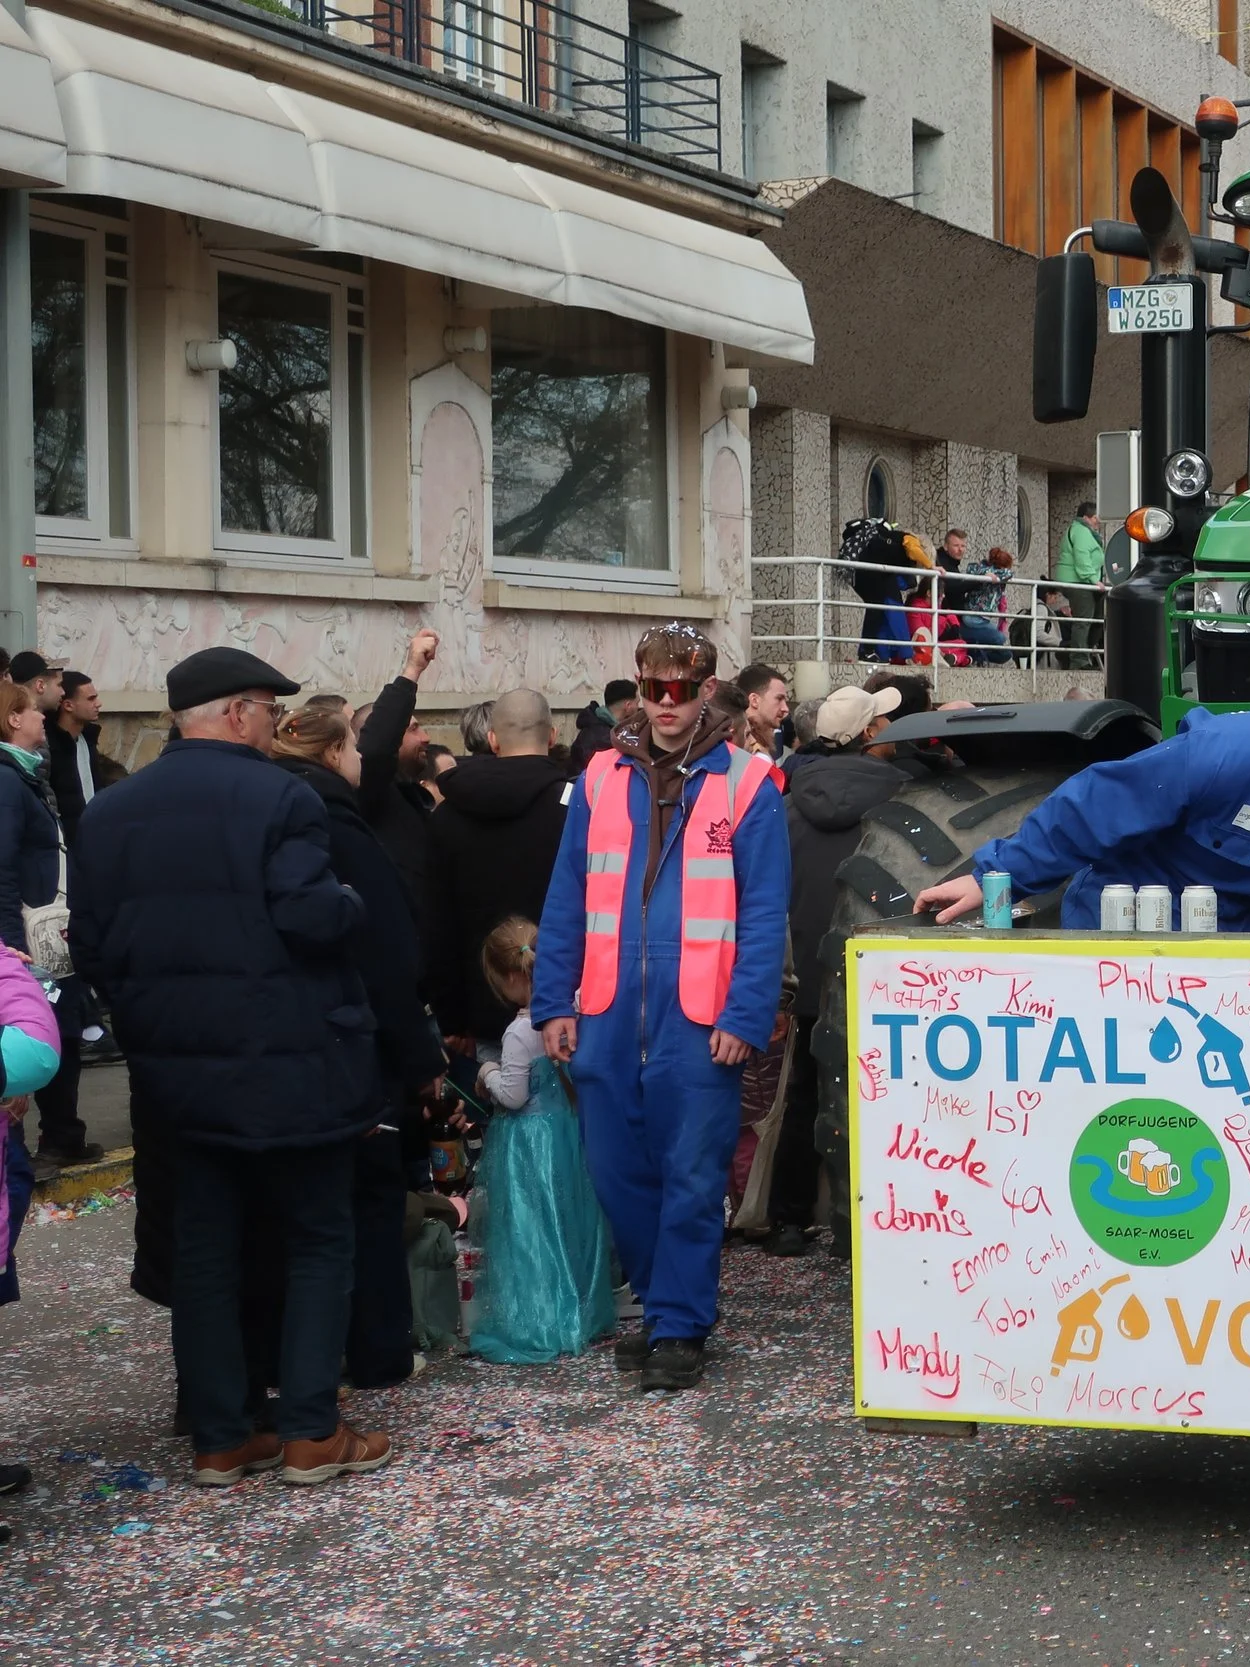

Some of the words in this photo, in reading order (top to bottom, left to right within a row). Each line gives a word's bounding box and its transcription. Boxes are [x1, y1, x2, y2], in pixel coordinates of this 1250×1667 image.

[1122, 289, 1160, 309] MZG
[1118, 310, 1130, 330] W
[1134, 309, 1183, 329] 6250
[900, 960, 1022, 988] Simon
[868, 979, 960, 1012] Mathis
[1003, 977, 1055, 1020] Kimi
[872, 1013, 1146, 1085] TOTAL
[923, 1086, 977, 1123] Mike
[987, 1089, 1040, 1136] Isi
[1098, 1115, 1198, 1128] DORFJUGEND
[886, 1123, 993, 1187] Nicole
[1105, 1227, 1195, 1239] SAAR-MOSEL
[952, 1242, 1011, 1293] Emma
[1139, 1249, 1161, 1260] E.V.
[1051, 1247, 1101, 1305] Naomi
[974, 1297, 1036, 1337] Tobi
[1066, 1372, 1206, 1416] Marcus
